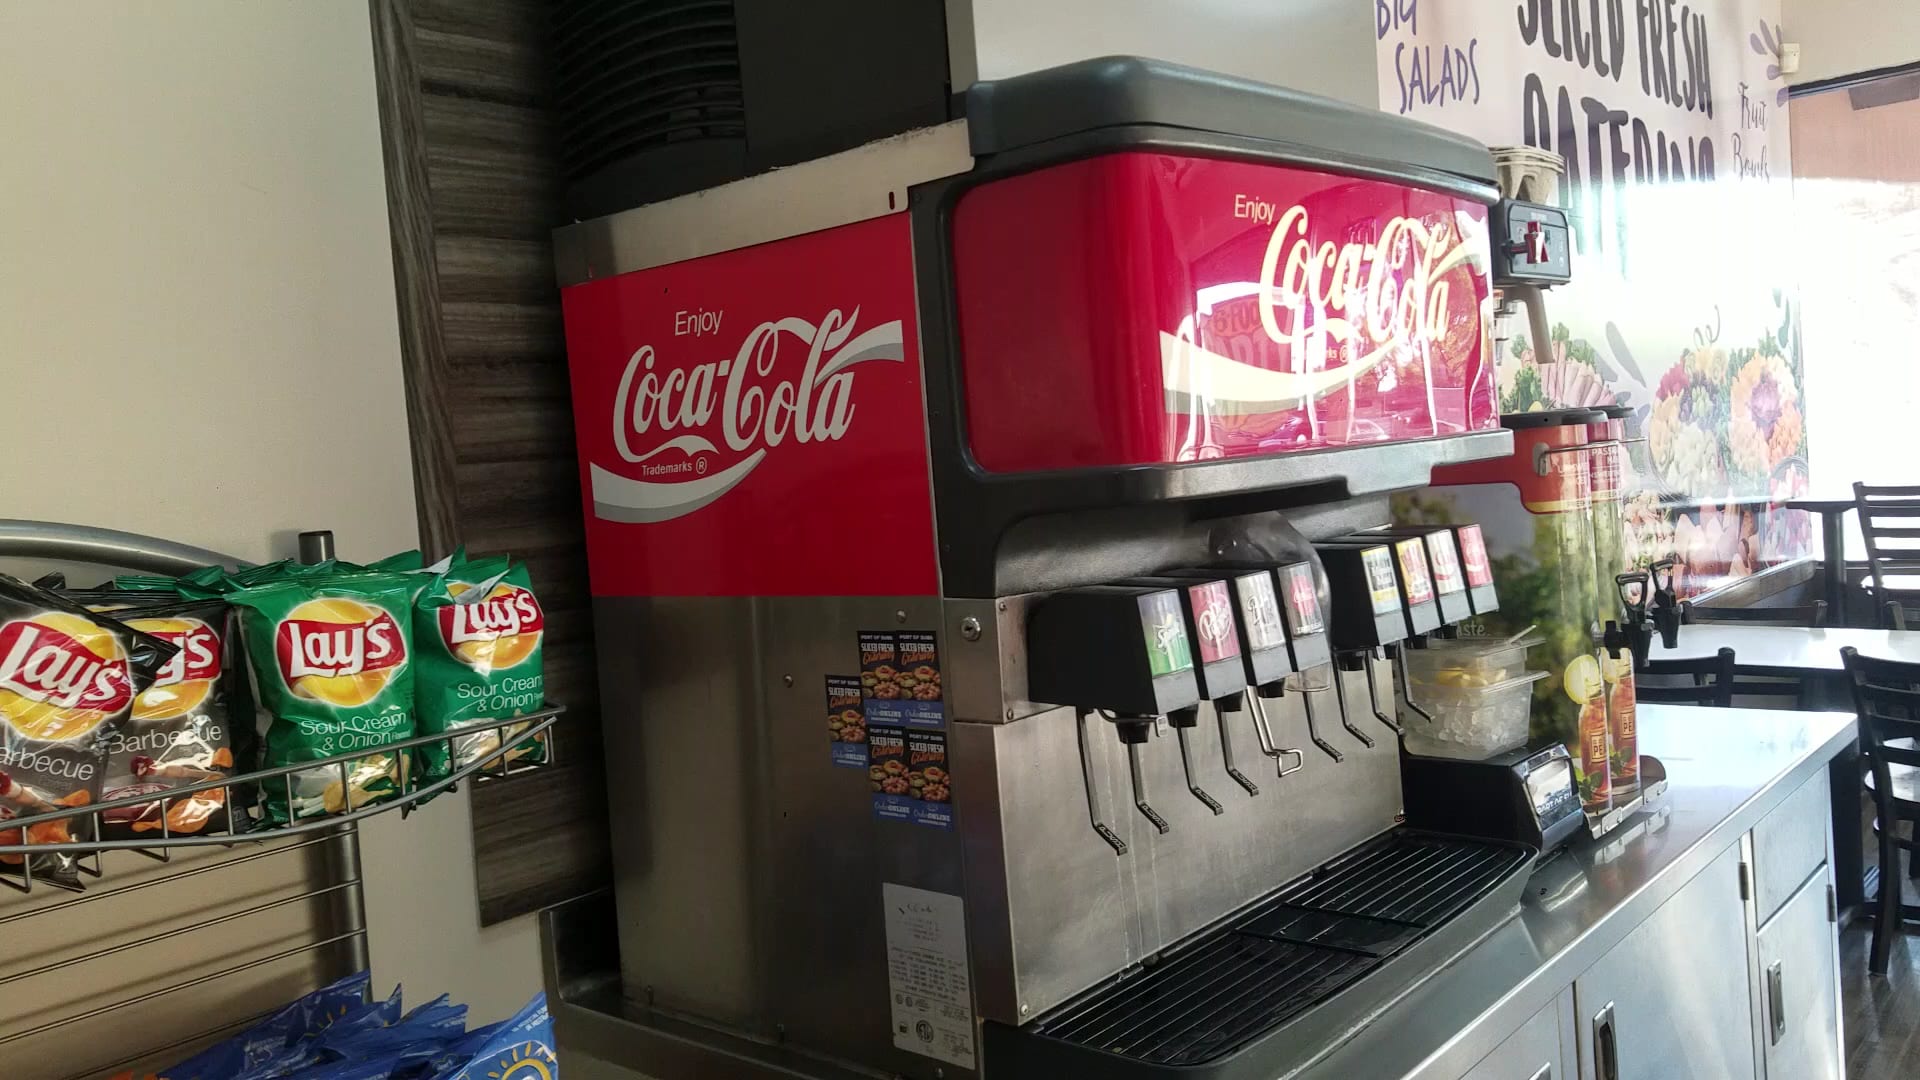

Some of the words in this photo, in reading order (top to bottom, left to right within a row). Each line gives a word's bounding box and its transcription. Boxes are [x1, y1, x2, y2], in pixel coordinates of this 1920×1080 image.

[1395, 38, 1480, 115] SALADS
[1635, 0, 1714, 120] FRESH
[1234, 194, 1276, 225] Enjoy
[1259, 204, 1452, 344] Coca-Cola
[674, 307, 723, 337] Enjoy
[613, 303, 861, 463] Coca-Cola
[641, 460, 693, 477] Trademarks
[451, 591, 538, 644] Lay's
[156, 629, 214, 687] y's
[288, 619, 393, 678] Lay's
[0, 625, 123, 708] Lay's
[457, 683, 498, 699] Sour
[477, 699, 487, 713] &
[491, 693, 534, 711] Onion
[109, 725, 222, 755] Barbeue
[300, 718, 347, 737] Sour
[351, 711, 407, 732] Cream
[321, 737, 335, 751] &
[338, 731, 393, 750] Onion
[0, 746, 94, 781] arbecue
